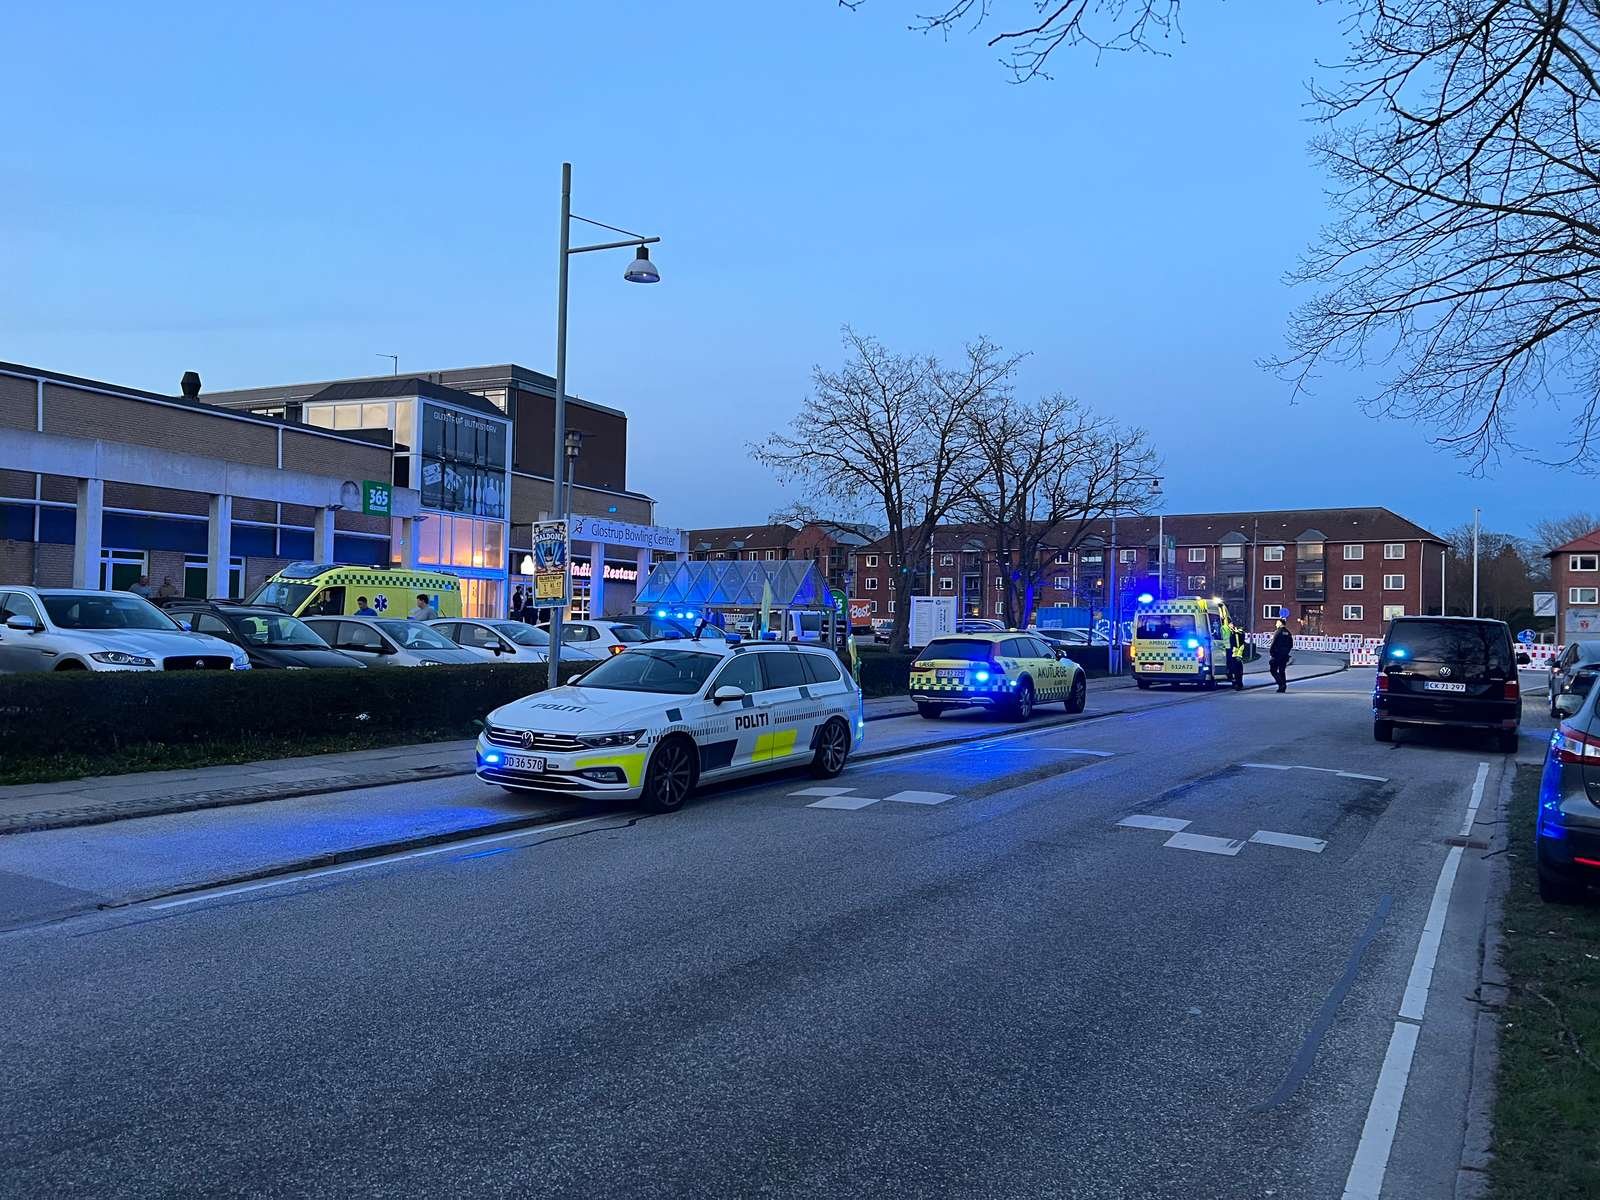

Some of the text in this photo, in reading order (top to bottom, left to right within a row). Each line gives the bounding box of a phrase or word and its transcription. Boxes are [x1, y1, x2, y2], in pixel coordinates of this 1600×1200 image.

[369, 488, 388, 506] 365
[591, 523, 676, 547] Glostrup Bowling Center
[1037, 666, 1067, 679] AKUTLÆGE
[531, 703, 587, 713] POLITI
[735, 712, 769, 731] POLITI
[515, 757, 526, 769] 36
[527, 758, 543, 770] 570
